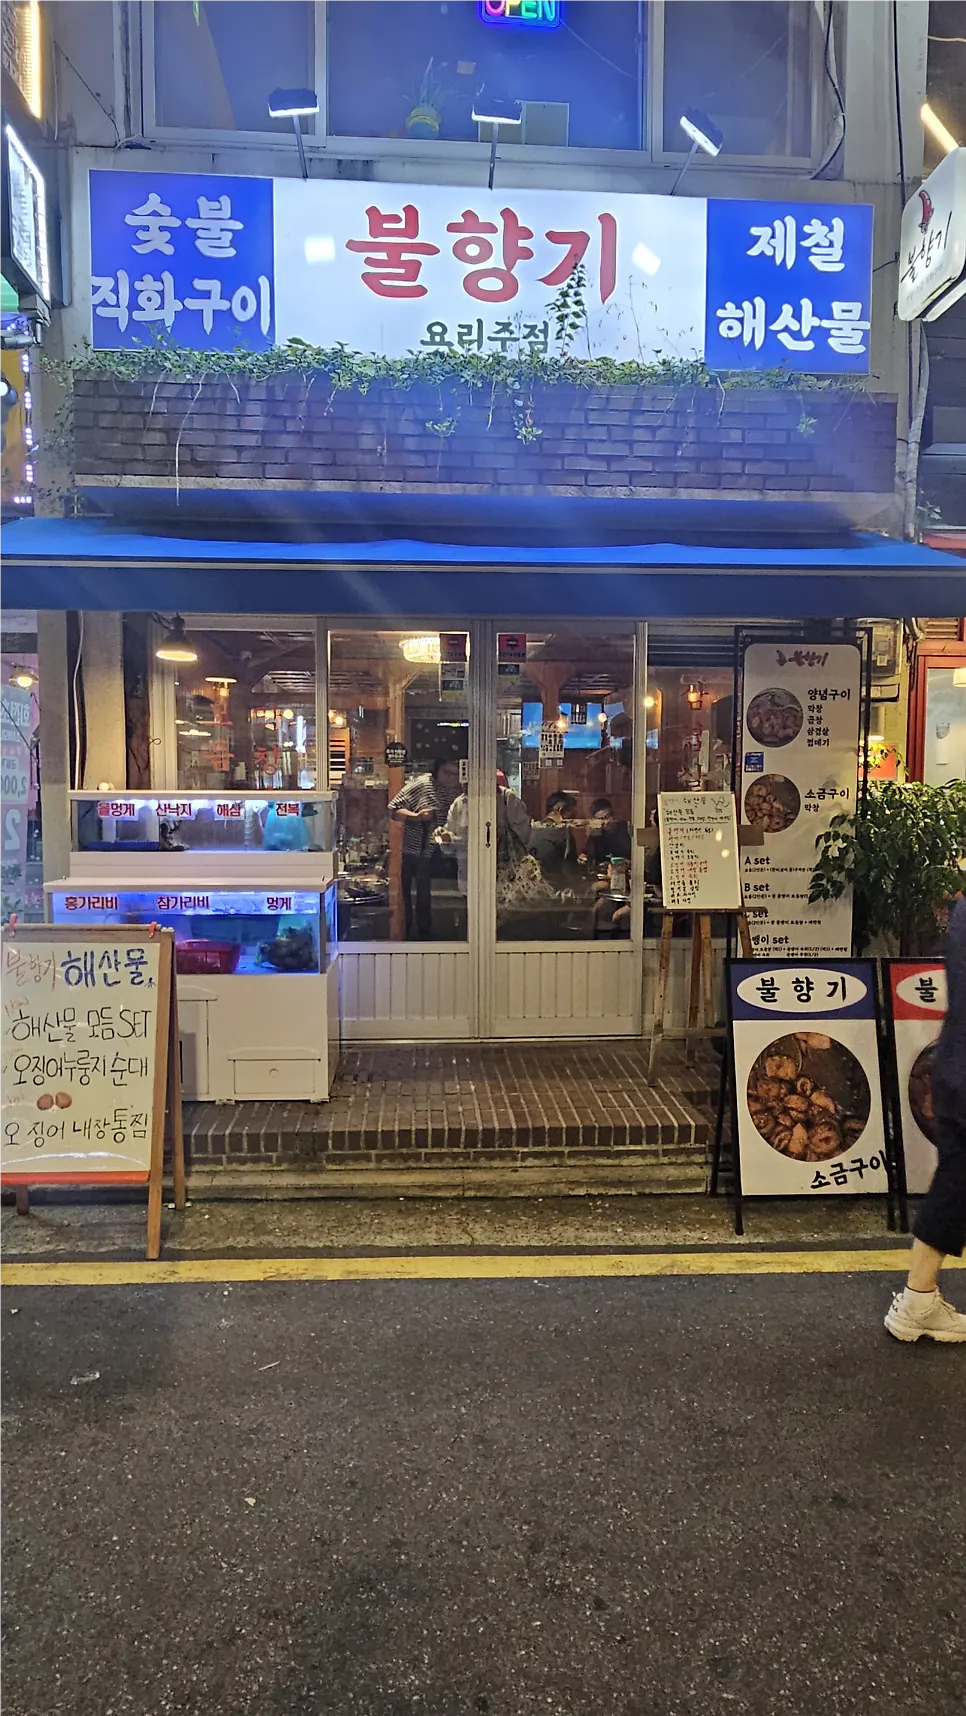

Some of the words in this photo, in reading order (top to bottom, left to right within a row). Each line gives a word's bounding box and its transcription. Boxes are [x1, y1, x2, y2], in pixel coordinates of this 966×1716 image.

[485, 0, 556, 21] OPEN
[124, 192, 244, 258] 숯불
[746, 215, 845, 272] 제철
[901, 211, 952, 283] 불향기
[345, 204, 617, 304] 불향기
[91, 269, 271, 335] 직화구이
[716, 296, 871, 354] 해산물
[420, 318, 550, 353] 요리주점
[807, 688, 851, 701] 양념구이
[807, 704, 823, 713] 막창
[807, 715, 823, 725] 곱창
[806, 726, 829, 737] 삼겹살
[804, 787, 850, 800] 소금구이
[155, 802, 192, 817] 산낙지
[216, 803, 243, 817] 해삼
[275, 802, 300, 817] 전복
[804, 803, 820, 812] 막창
[744, 856, 752, 865] A
[754, 856, 771, 865] set
[744, 883, 751, 891] B
[753, 883, 770, 891] set
[65, 896, 118, 910] 홍가리비
[157, 896, 210, 910] 참가리비
[266, 896, 292, 911] 멍게
[752, 910, 769, 918] set
[772, 935, 789, 944] set
[60, 948, 148, 988] 해산물
[11, 1008, 76, 1043] 해산물
[811, 1150, 888, 1189] 소금구이
